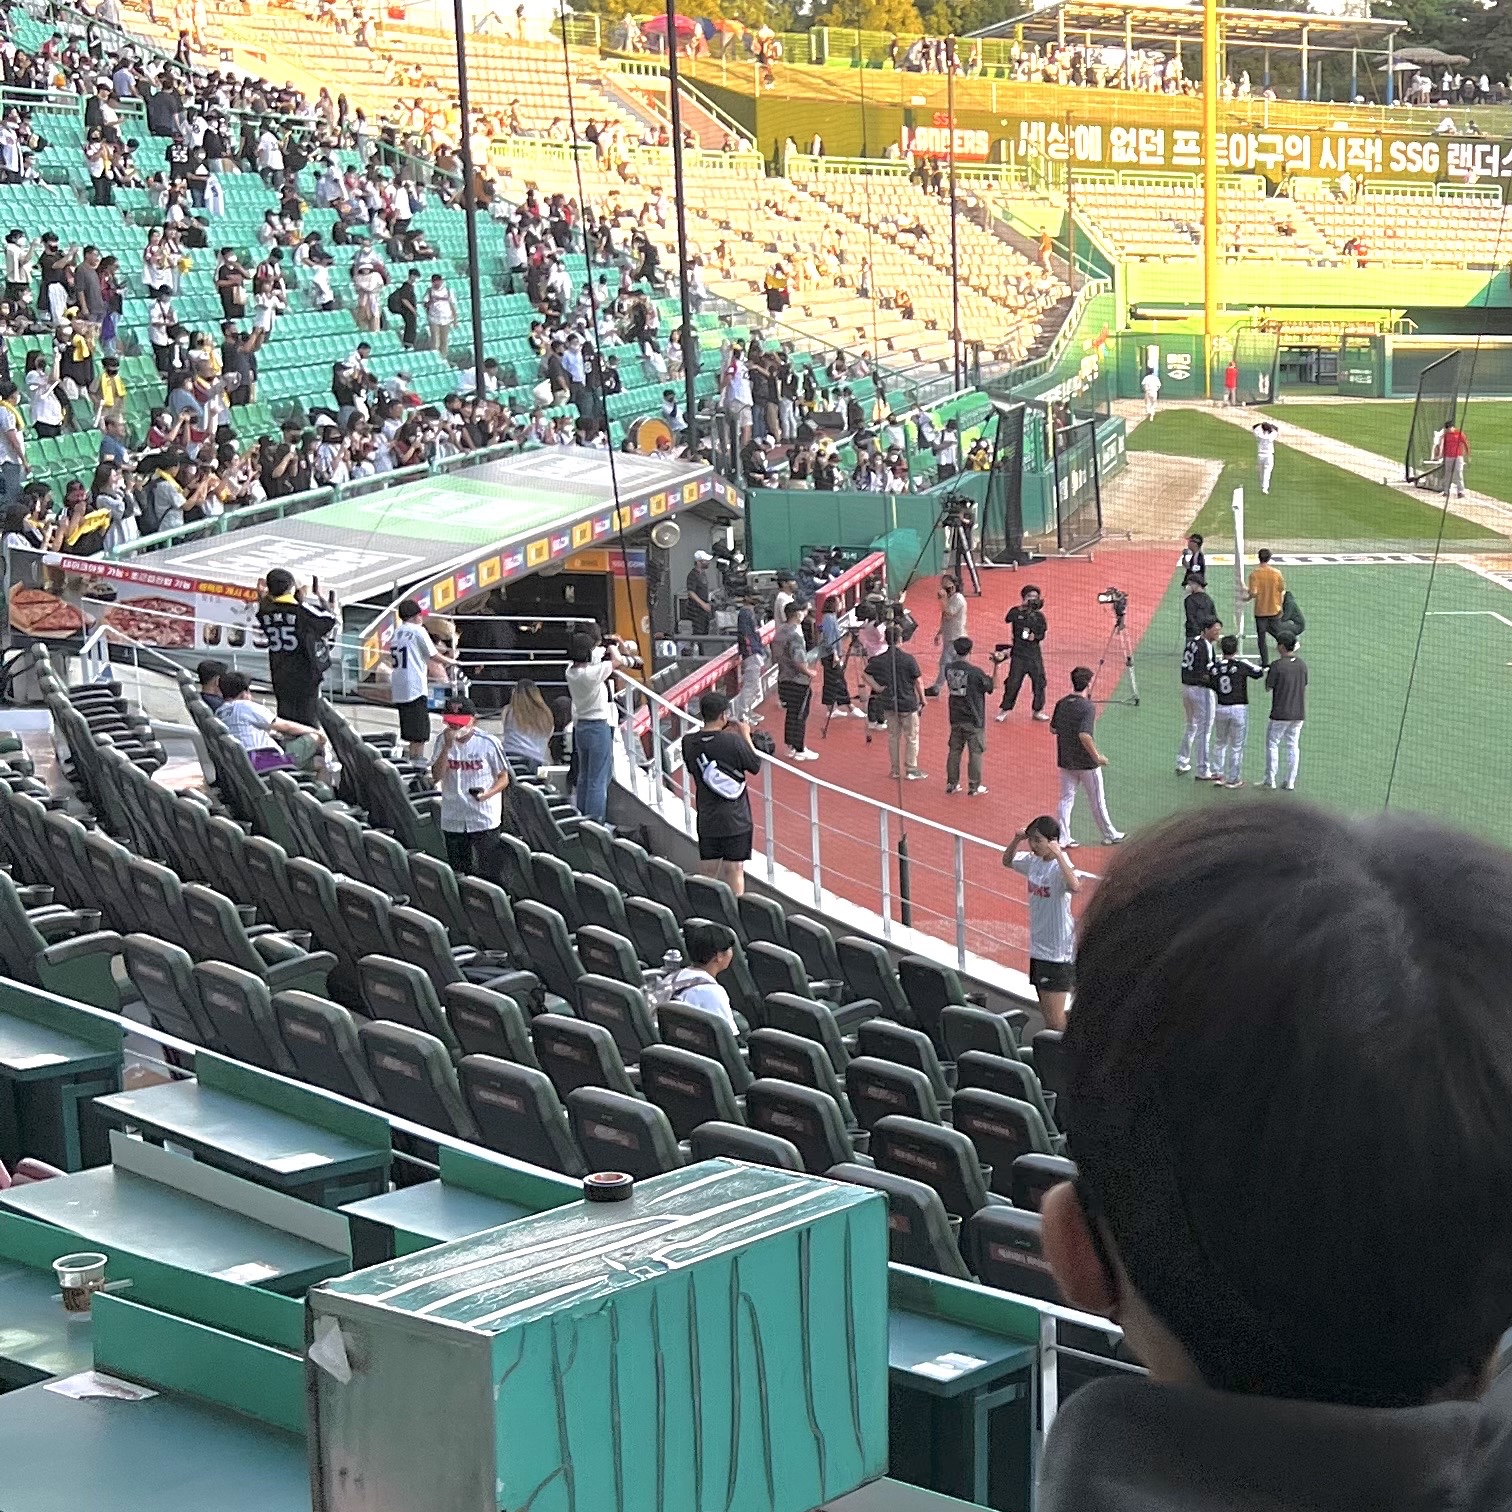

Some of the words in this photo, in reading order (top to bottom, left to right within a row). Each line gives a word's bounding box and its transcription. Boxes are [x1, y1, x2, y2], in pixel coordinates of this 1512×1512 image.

[1018, 120, 1103, 162] 세상에
[1110, 127, 1166, 166] 없던
[1172, 130, 1311, 172] 프로야구의
[1318, 134, 1383, 174] 시작!
[1389, 140, 1440, 174] SSG
[267, 626, 298, 652] 35
[1219, 675, 1233, 694] 8
